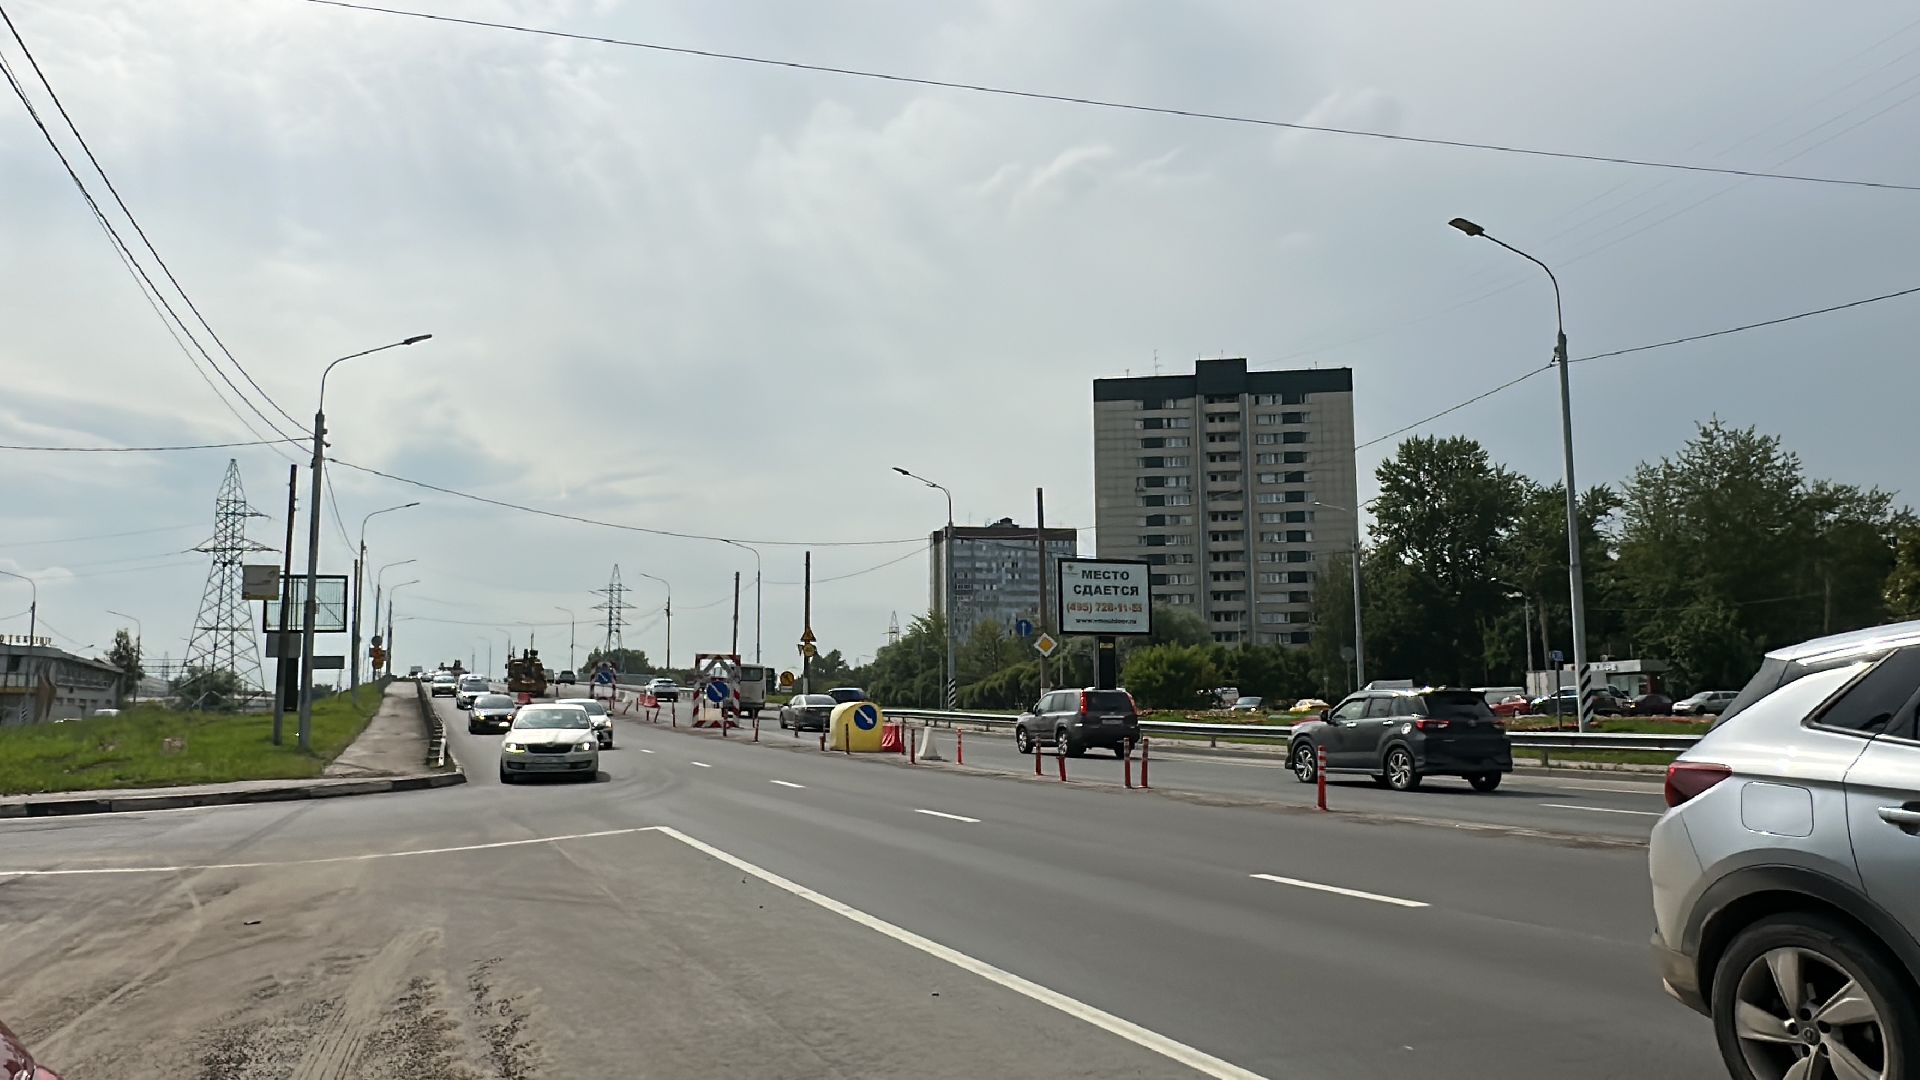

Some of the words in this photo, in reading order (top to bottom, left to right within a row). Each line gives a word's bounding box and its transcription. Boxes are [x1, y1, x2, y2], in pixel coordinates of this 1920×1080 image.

[1081, 570, 1130, 580] МЕСТО
[1073, 585, 1139, 596] СДАЕТСЯ
[1067, 602, 1092, 614] (495)
